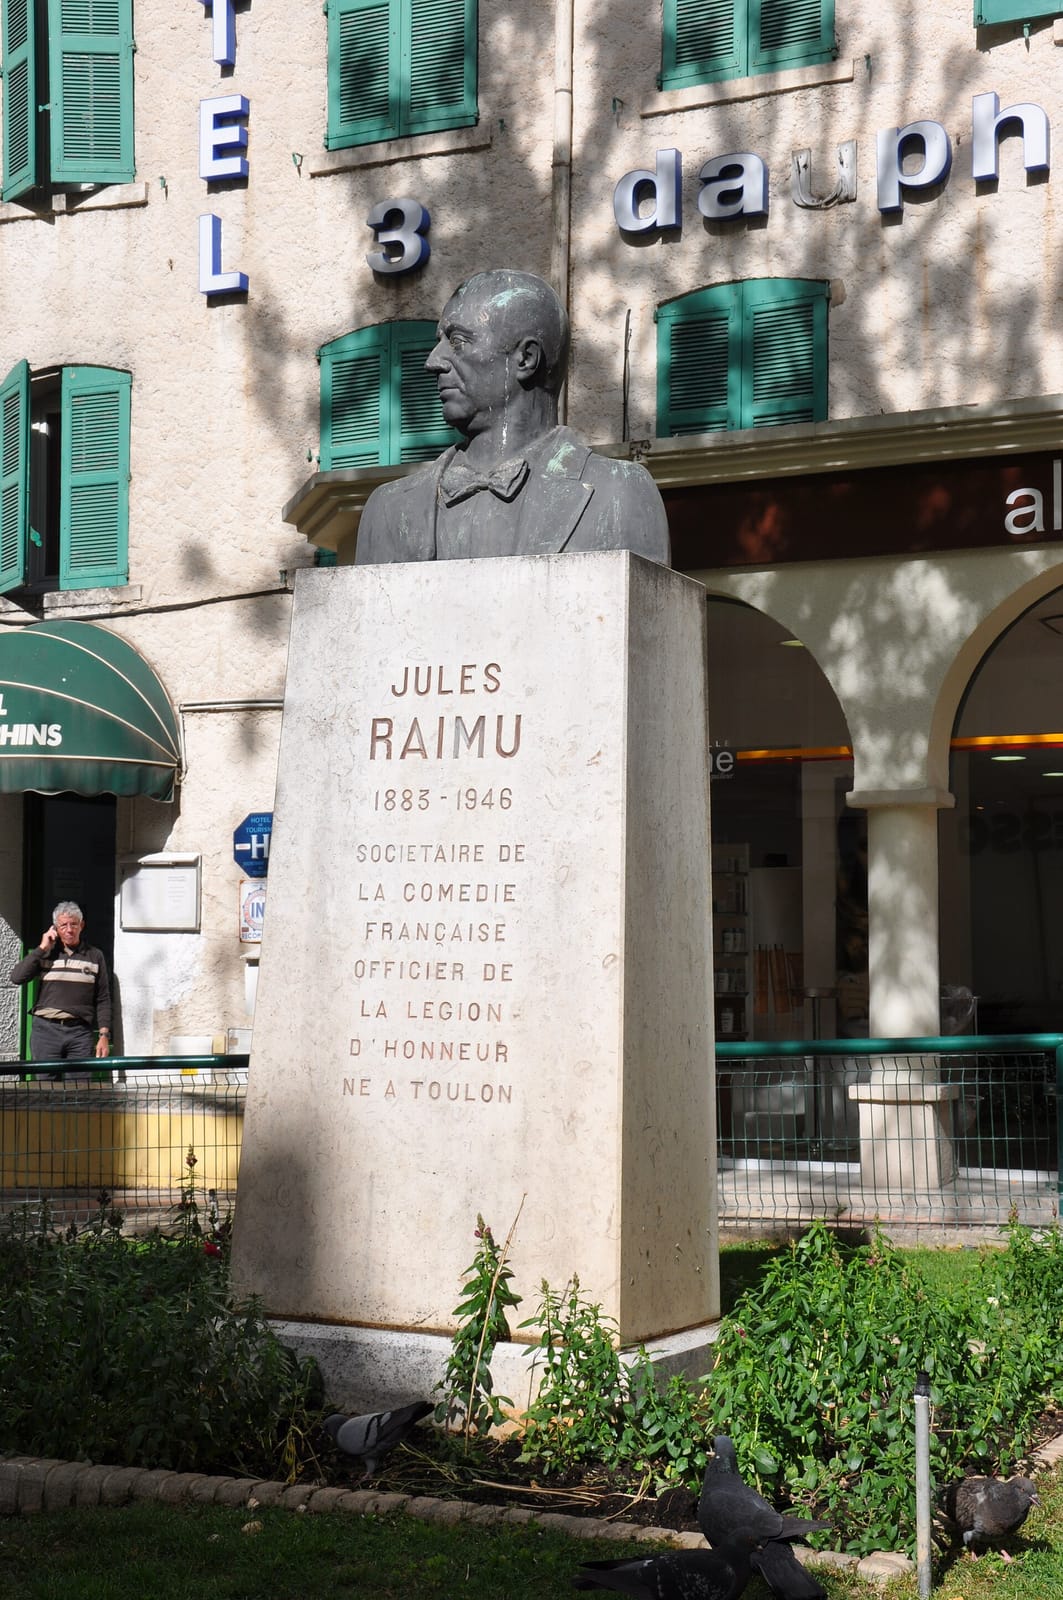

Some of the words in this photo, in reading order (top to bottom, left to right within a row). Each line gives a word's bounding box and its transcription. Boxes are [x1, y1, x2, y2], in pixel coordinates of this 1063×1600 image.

[366, 199, 432, 275] 3
[613, 91, 1050, 236] dauph
[1004, 459, 1062, 535] al
[391, 662, 502, 698] JULES
[369, 714, 522, 760] RAIMU
[356, 844, 485, 863] SOCIETAIRE
[499, 844, 526, 863] DE
[358, 883, 386, 901] LA
[403, 883, 517, 902] COMEDIE
[365, 922, 507, 948] FRANÇAISE
[354, 960, 465, 981] OFFICIER
[483, 963, 514, 982] DE
[360, 1000, 388, 1019] LA
[407, 1001, 503, 1022] LEGION
[350, 1038, 509, 1063] D'HONNEUR
[342, 1078, 372, 1097] NE
[384, 1080, 397, 1098] A
[410, 1081, 513, 1103] TOULON
